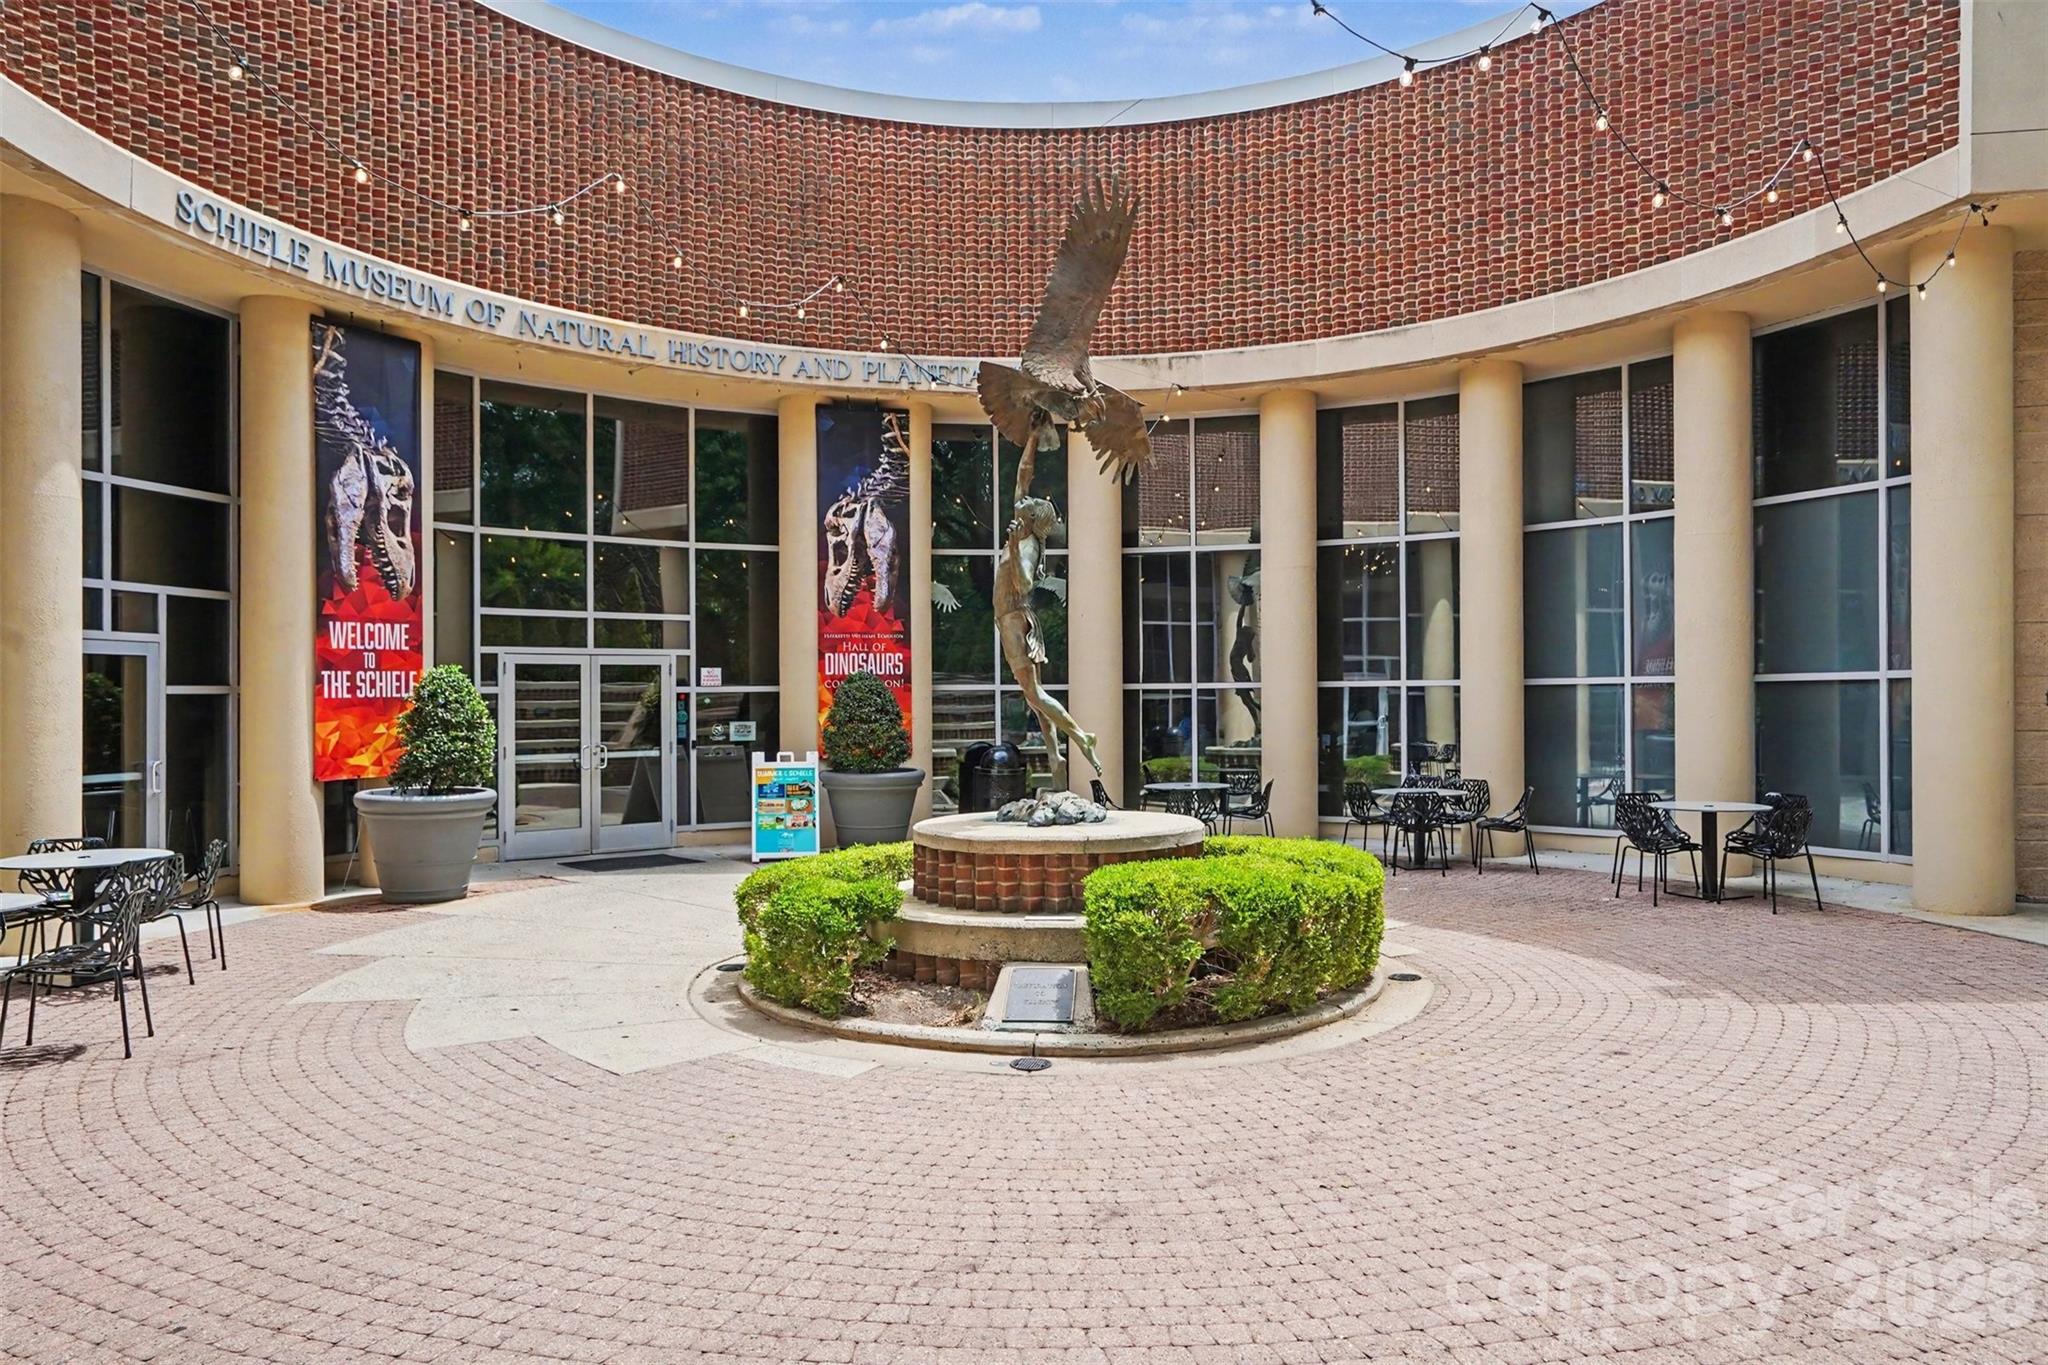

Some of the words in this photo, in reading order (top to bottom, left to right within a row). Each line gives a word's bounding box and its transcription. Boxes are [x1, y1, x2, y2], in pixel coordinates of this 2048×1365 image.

[176, 190, 309, 272] SCHIELE
[324, 250, 454, 317] MUSEUM
[465, 298, 505, 328] OF
[518, 309, 656, 359] NATURAL
[668, 339, 787, 376] HISTORY
[793, 355, 852, 382] AND
[328, 620, 410, 650] WELCOME
[842, 641, 868, 652] HALL
[872, 642, 887, 652] OF
[363, 651, 376, 669] TO
[824, 652, 904, 676] DINOSAURS
[321, 670, 352, 699] THE
[356, 670, 418, 699] SCHIELE
